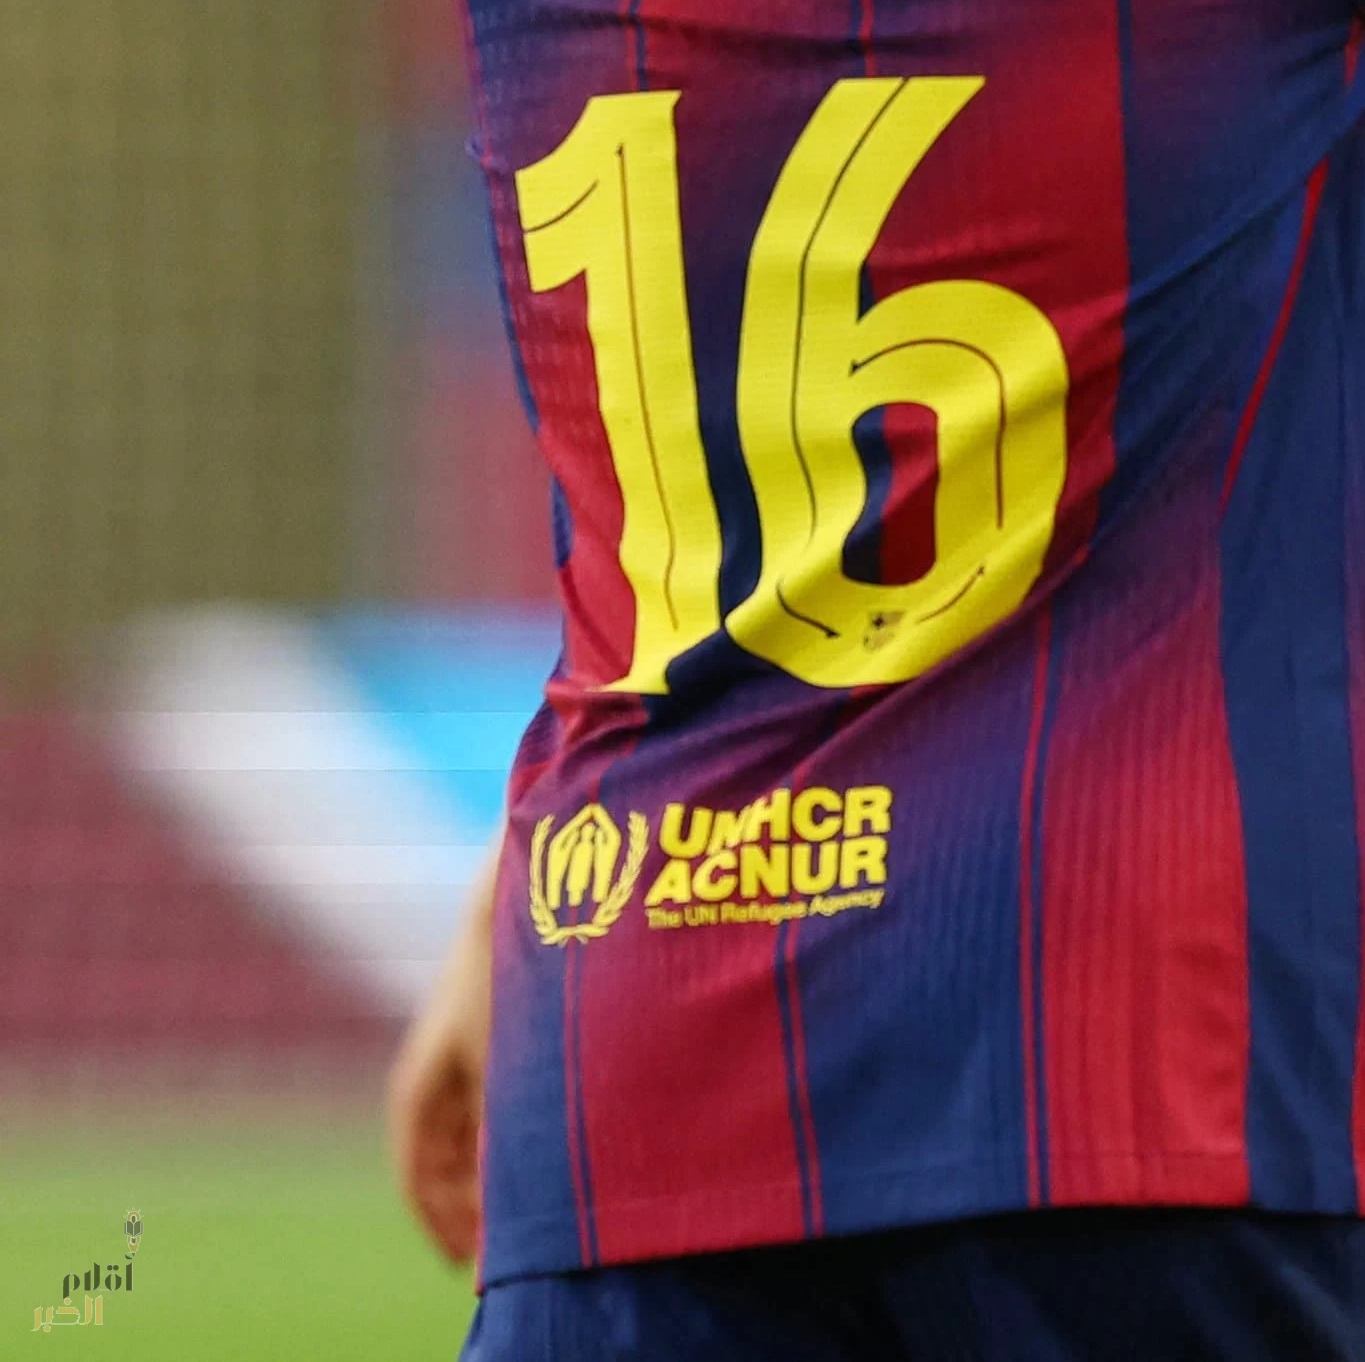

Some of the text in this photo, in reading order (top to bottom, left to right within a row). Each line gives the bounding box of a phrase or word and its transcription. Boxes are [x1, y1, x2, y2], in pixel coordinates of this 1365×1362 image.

[513, 75, 1070, 694] 16
[659, 785, 893, 859] UNHCR
[644, 836, 889, 907] ACNUR
